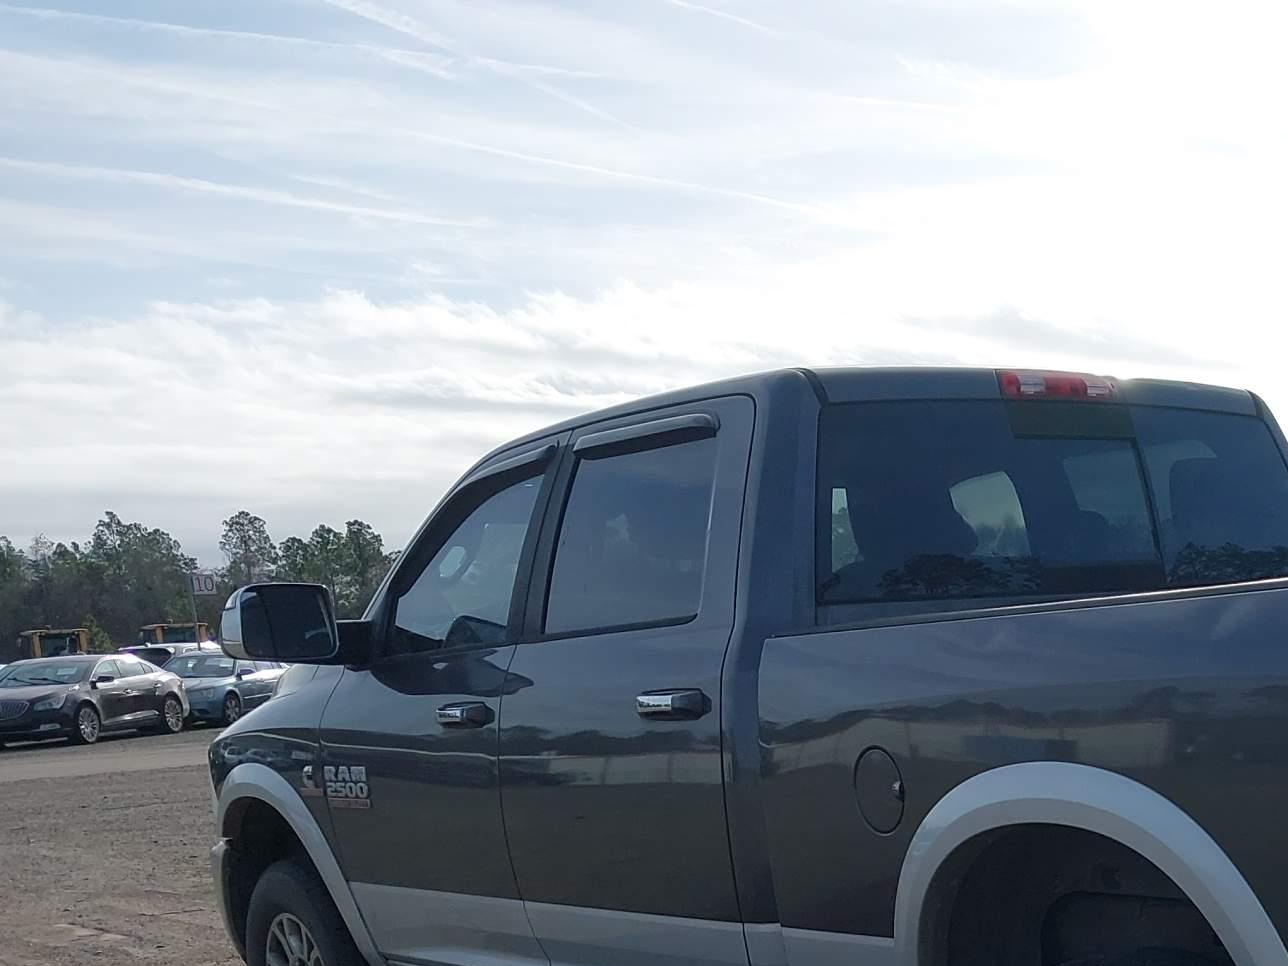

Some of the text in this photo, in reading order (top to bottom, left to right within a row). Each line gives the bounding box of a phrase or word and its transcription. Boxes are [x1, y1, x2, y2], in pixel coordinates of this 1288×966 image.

[195, 576, 215, 592] 10
[323, 766, 367, 782] RAM
[325, 782, 369, 798] 2500
